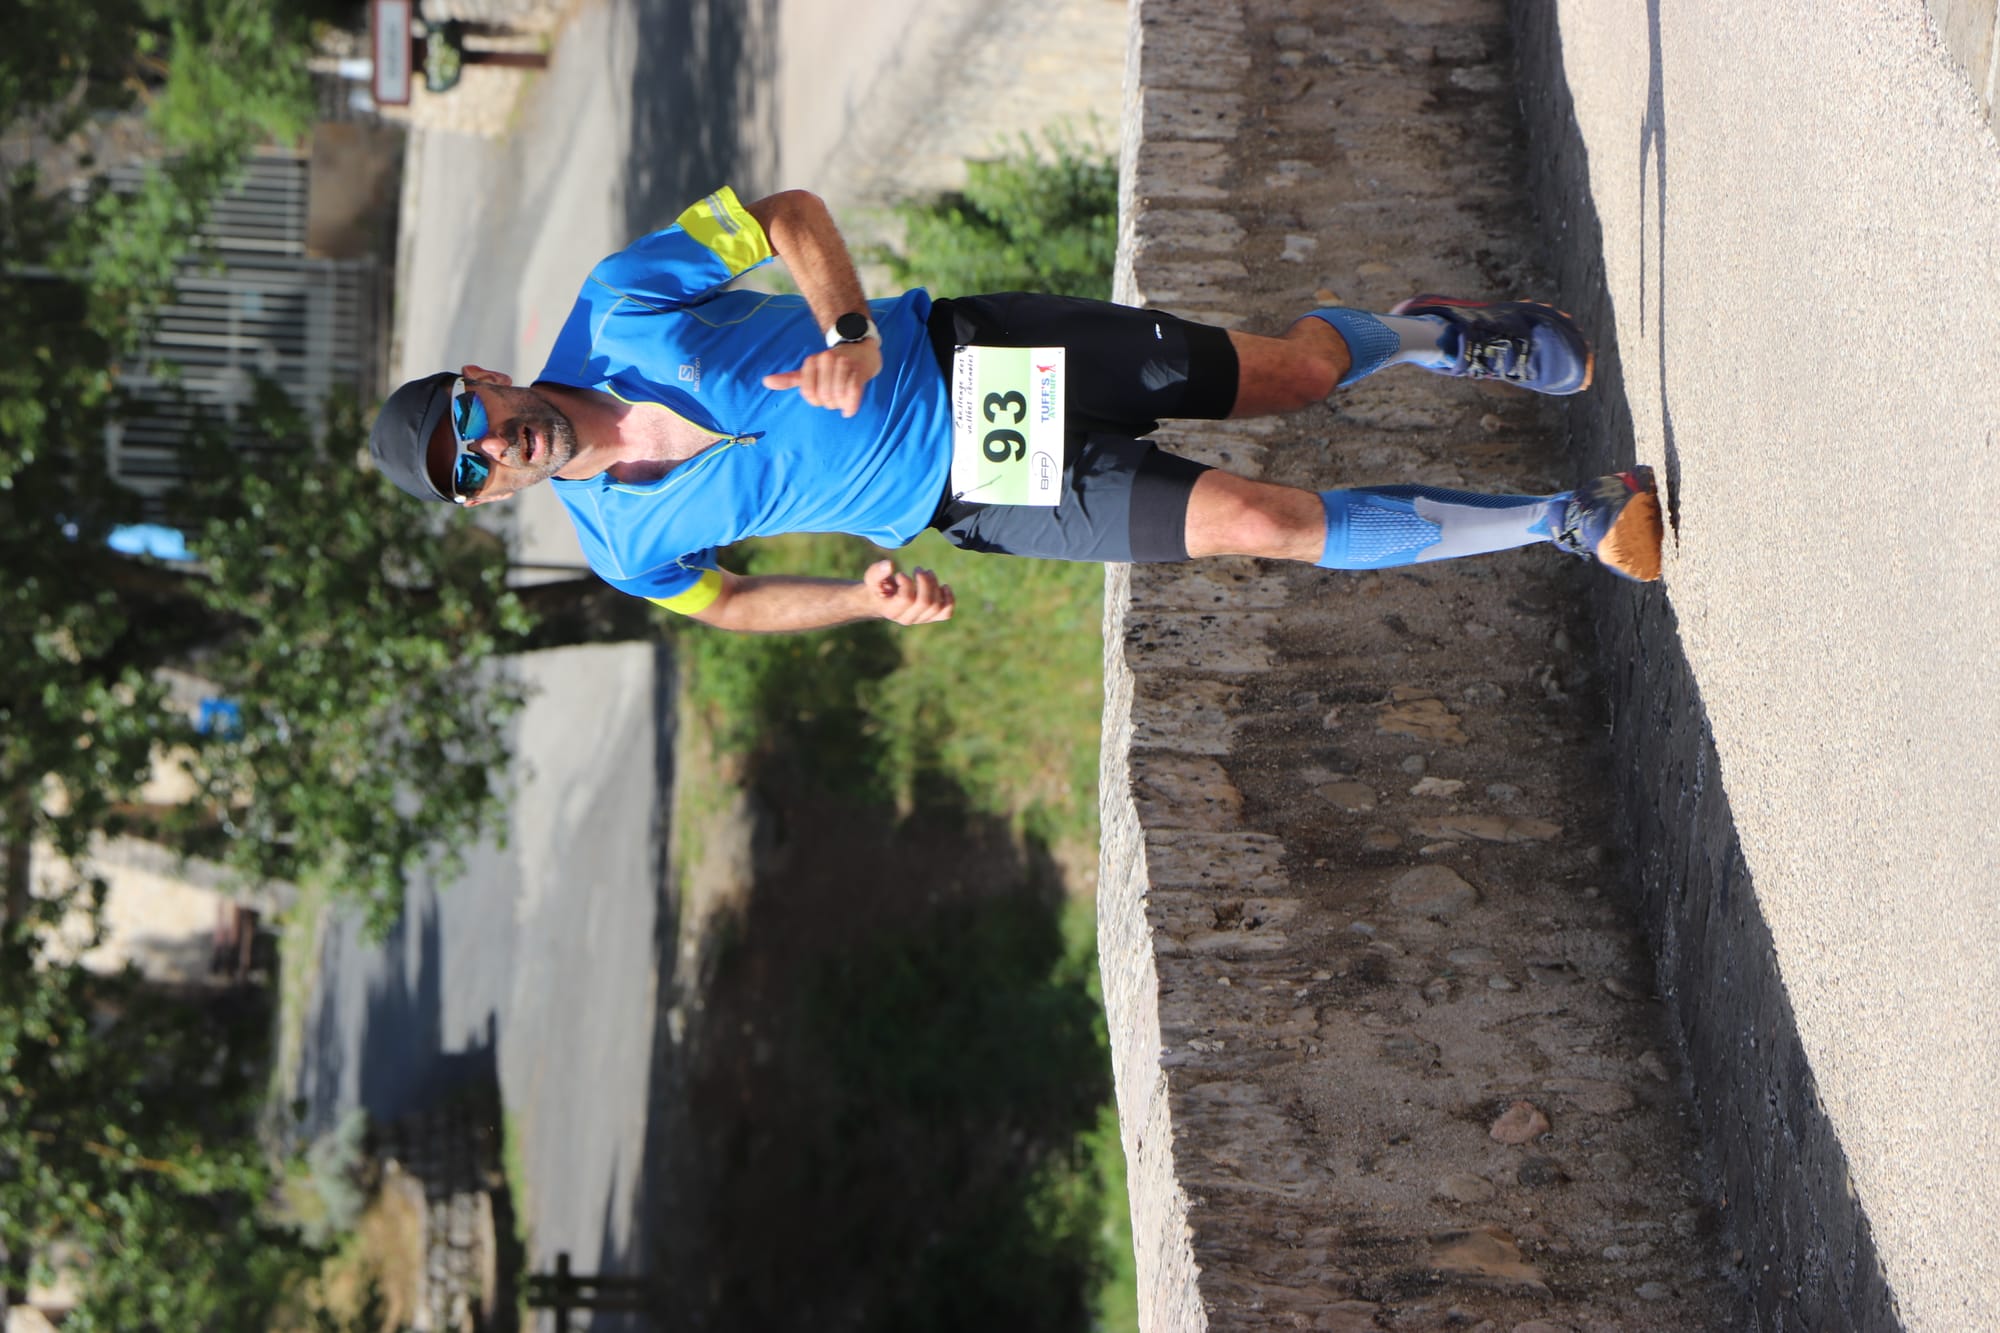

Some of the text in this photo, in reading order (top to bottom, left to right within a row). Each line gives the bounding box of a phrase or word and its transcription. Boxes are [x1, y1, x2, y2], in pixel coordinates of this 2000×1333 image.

[955, 382, 966, 428] Challenge
[1041, 378, 1049, 423] TUFF'S
[982, 390, 1026, 463] 93
[1040, 457, 1049, 490] BFP
